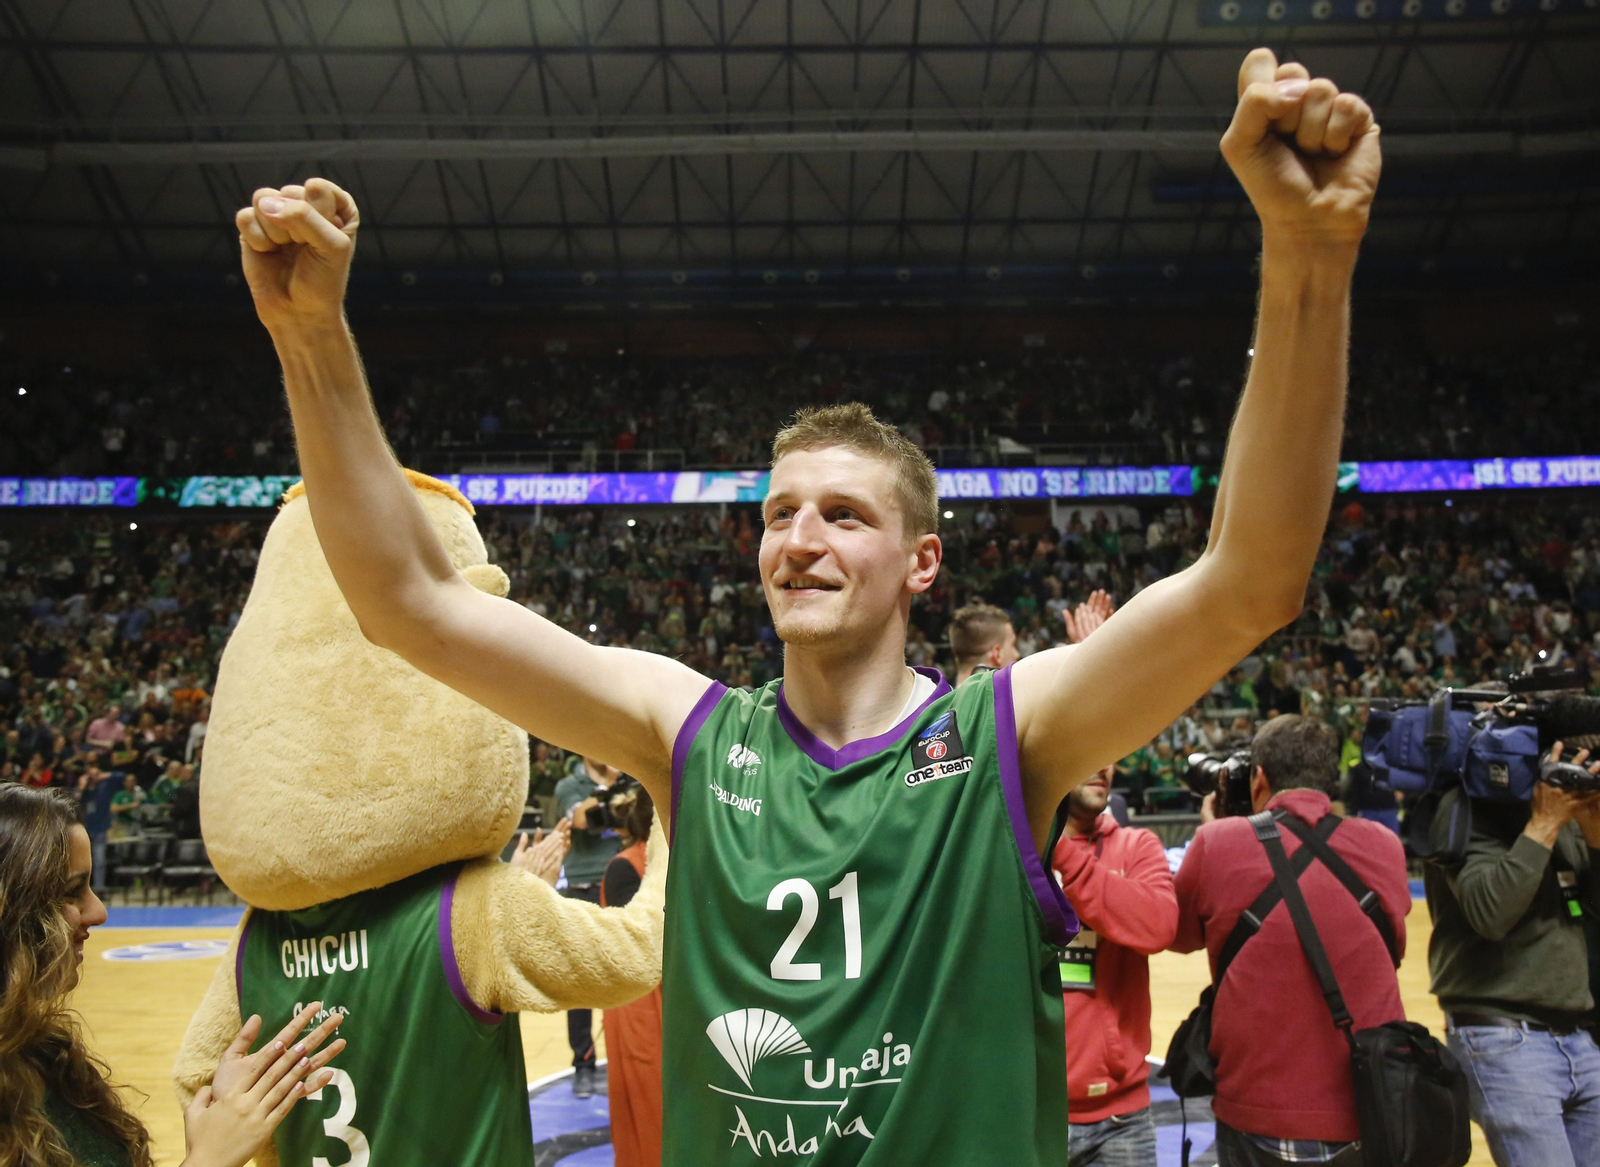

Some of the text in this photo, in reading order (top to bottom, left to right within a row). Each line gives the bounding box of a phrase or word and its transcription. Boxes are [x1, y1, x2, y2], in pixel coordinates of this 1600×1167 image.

[938, 469, 1172, 497] AGA NO SE RINDE
[1510, 461, 1542, 484] SE
[1545, 460, 1600, 483] PUE
[0, 480, 115, 505] E RINDE
[467, 478, 498, 501] SE
[503, 478, 588, 501] PUEDE!
[766, 871, 862, 981] 21
[281, 929, 369, 979] CHICUI
[305, 1065, 371, 1167] 3
